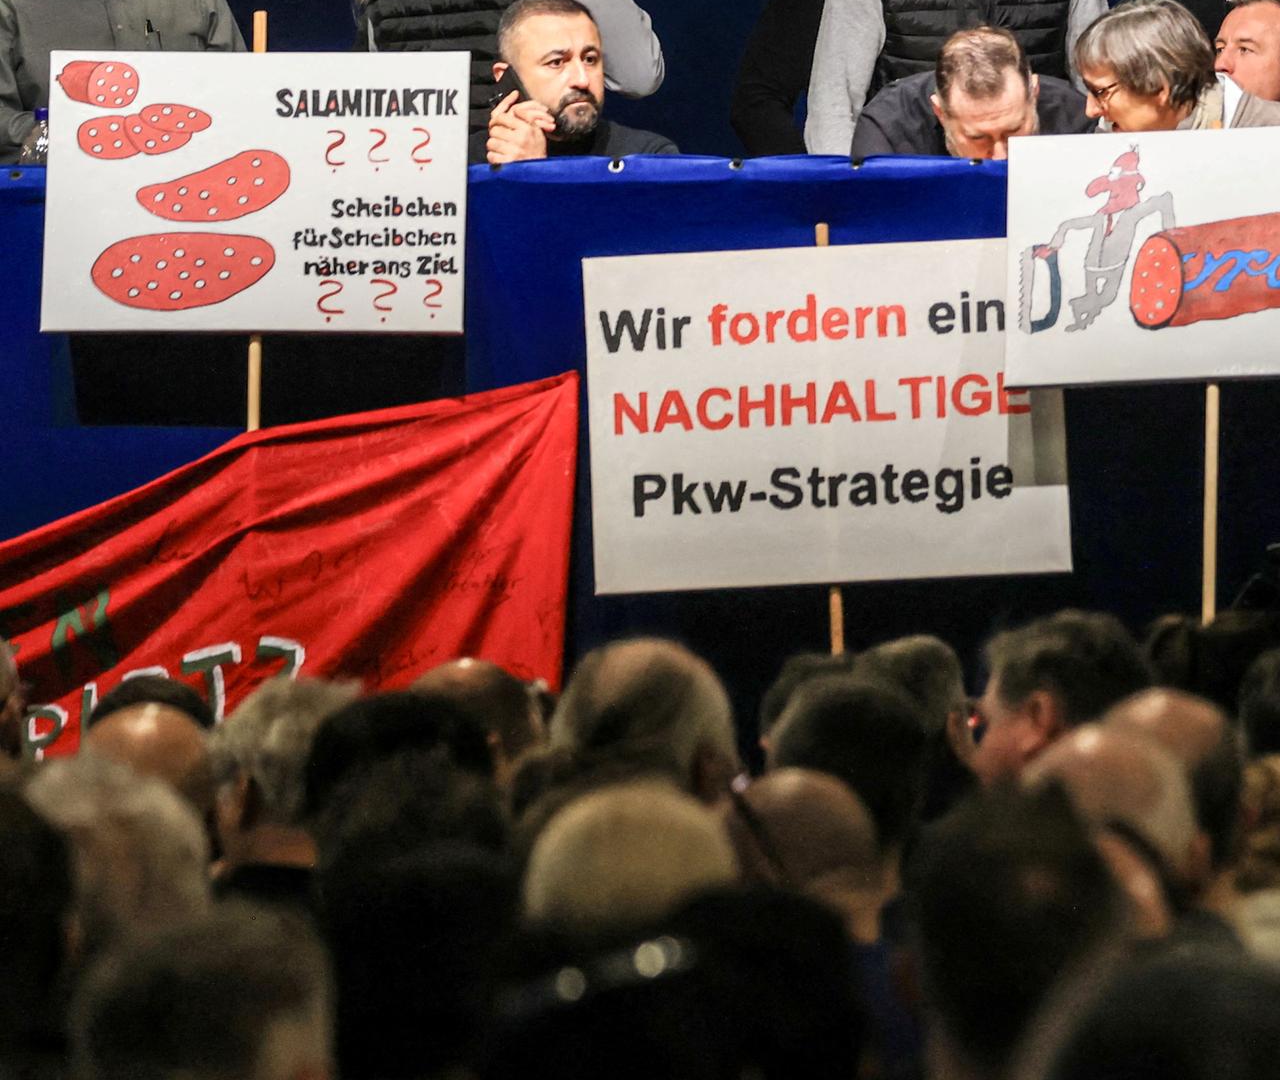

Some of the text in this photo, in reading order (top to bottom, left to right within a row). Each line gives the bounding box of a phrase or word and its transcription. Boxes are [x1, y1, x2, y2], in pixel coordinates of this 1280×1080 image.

[276, 88, 458, 117] SALAMITAKTIK
[331, 195, 457, 218] Scheibchen
[292, 227, 457, 250] für Scheibchen
[304, 253, 458, 278] näher ans Ziel
[600, 307, 691, 353] Wir
[707, 293, 907, 346] fordern
[613, 372, 1031, 436] NACHHALTIGE
[633, 457, 1014, 517] Pkw-Strategie
